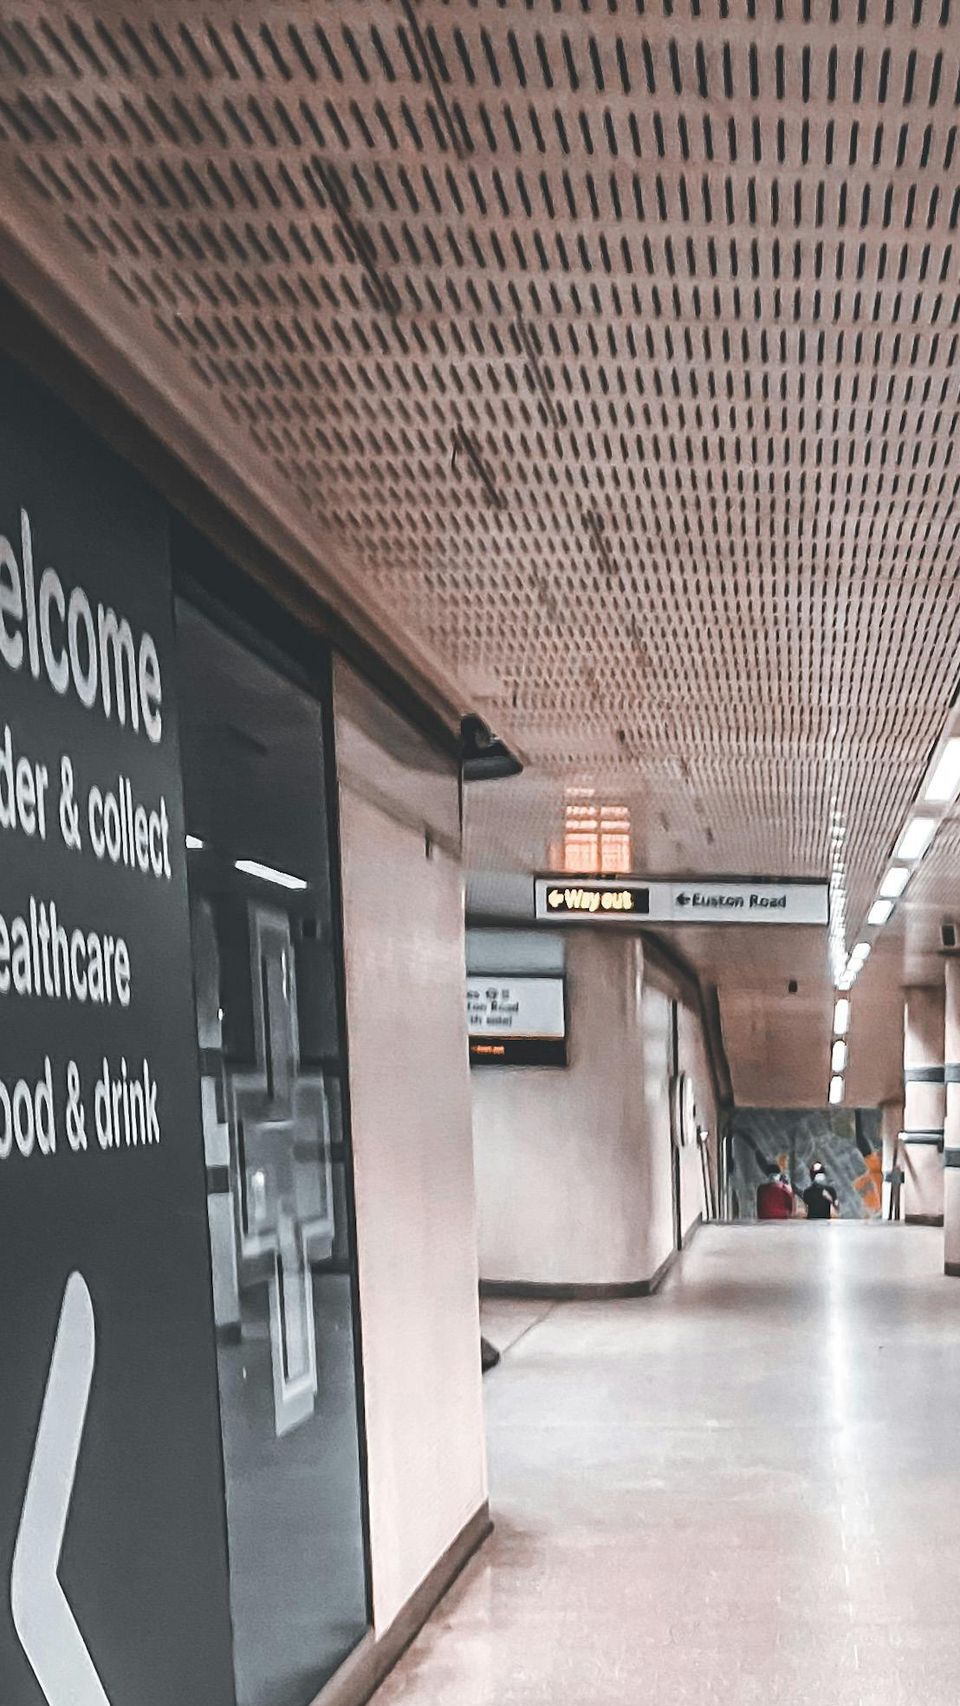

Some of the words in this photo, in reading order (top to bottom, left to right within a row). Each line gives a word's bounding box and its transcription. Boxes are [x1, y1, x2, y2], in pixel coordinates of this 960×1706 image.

[59, 755, 82, 851] &
[88, 774, 171, 879] collect
[564, 888, 599, 912] Way
[600, 890, 633, 910] out
[692, 893, 744, 909] Euston
[750, 893, 787, 909] Road
[66, 1060, 88, 1151] &
[95, 1057, 160, 1150] drink
